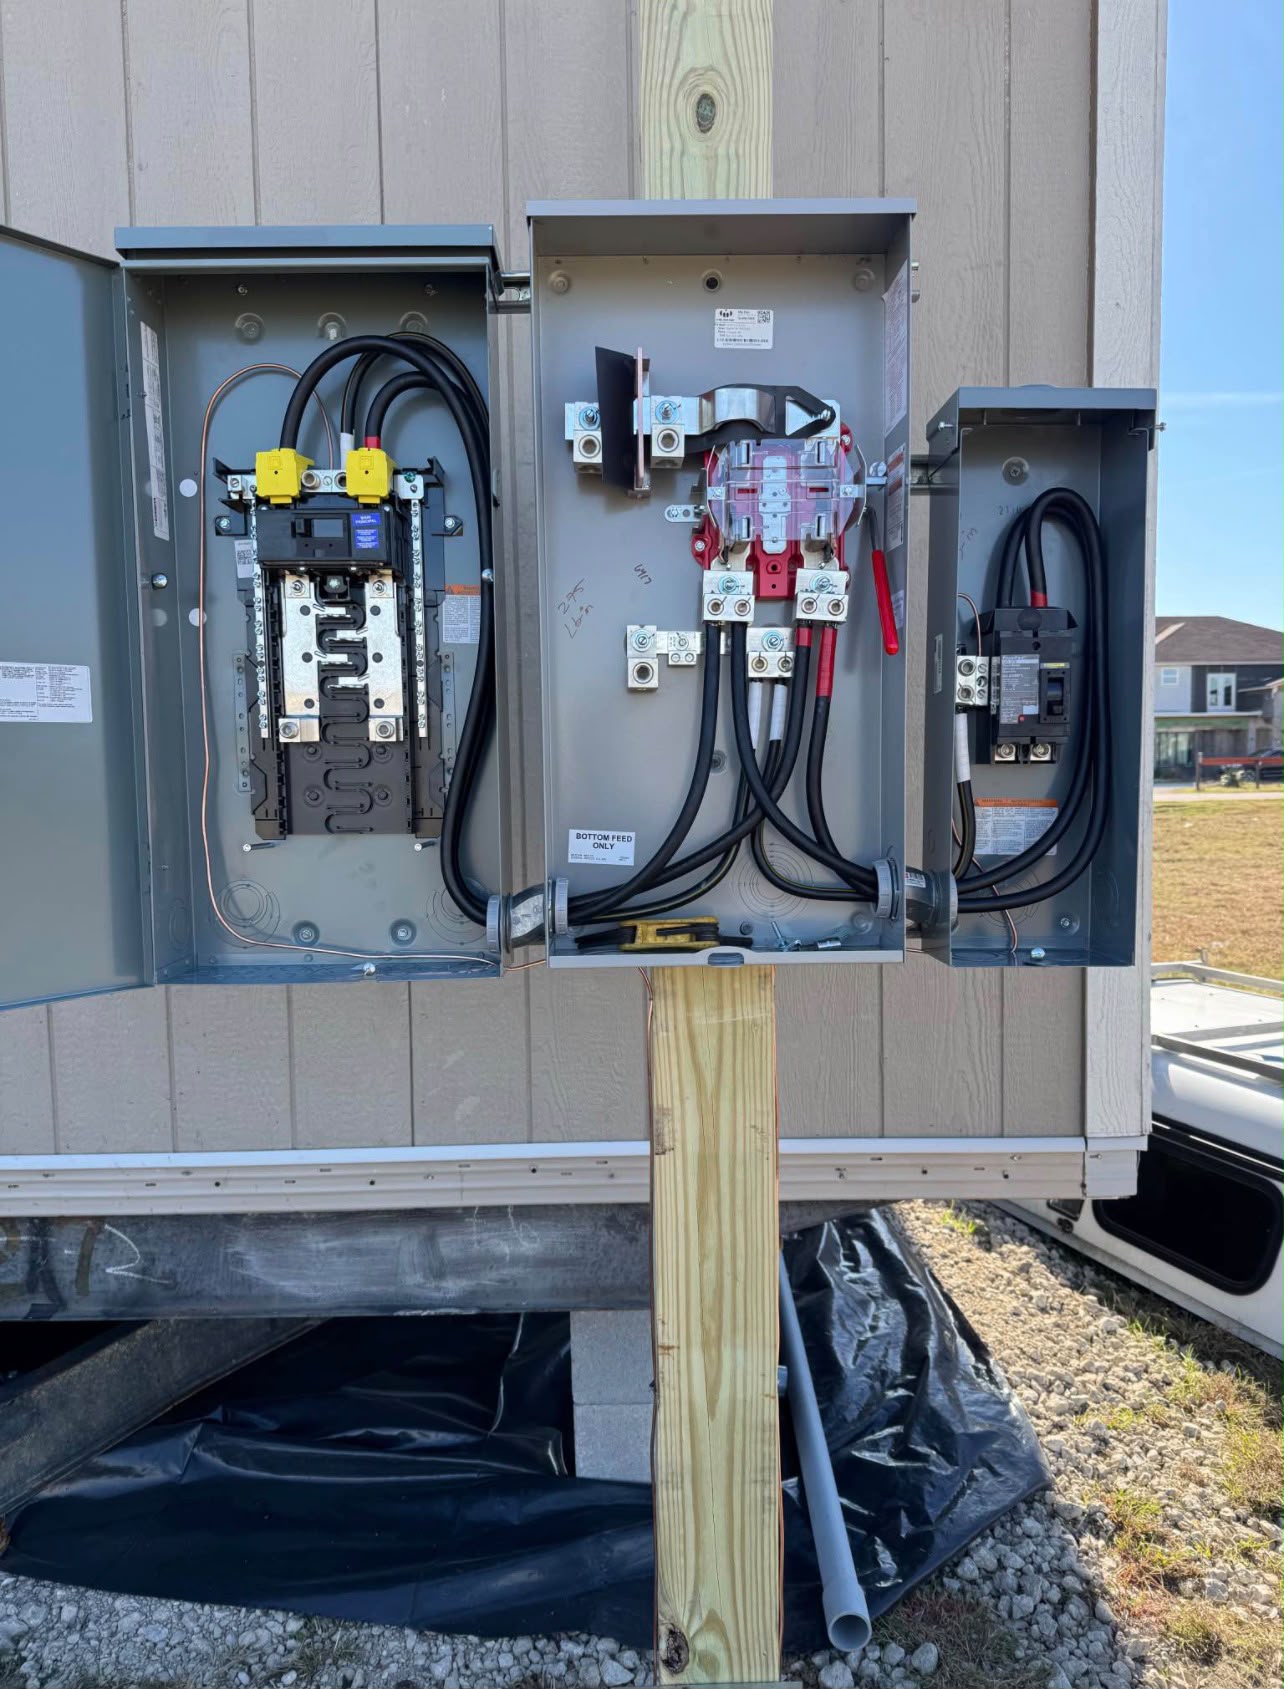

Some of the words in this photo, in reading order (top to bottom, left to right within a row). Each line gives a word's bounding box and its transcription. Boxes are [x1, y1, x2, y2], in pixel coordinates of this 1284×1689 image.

[576, 832, 610, 841] BOTTOM
[611, 834, 633, 843] FEED
[592, 842, 615, 850] ONLY
